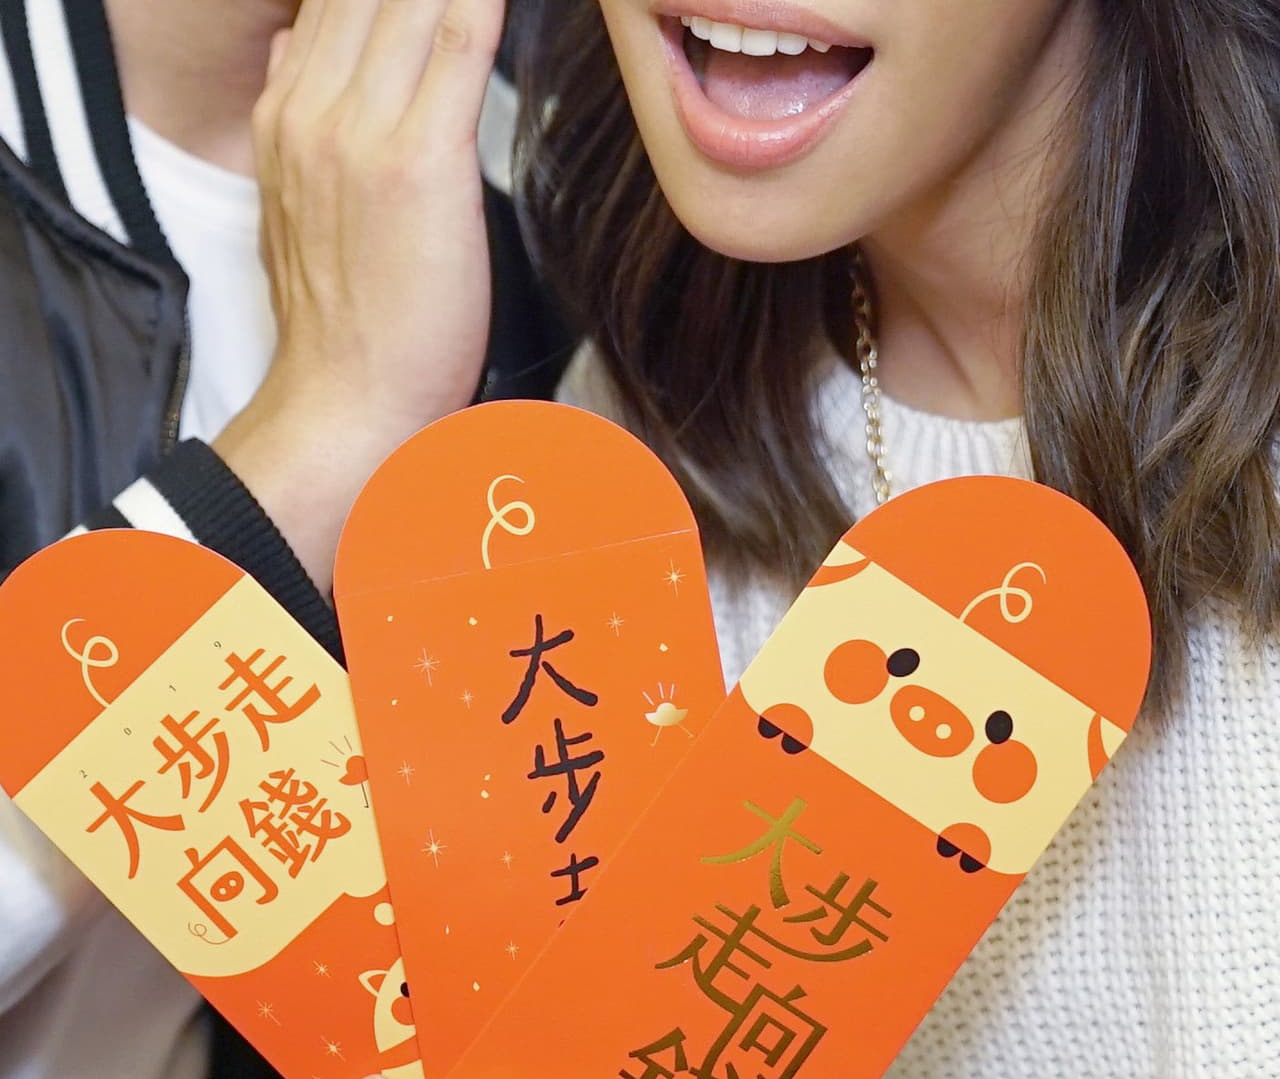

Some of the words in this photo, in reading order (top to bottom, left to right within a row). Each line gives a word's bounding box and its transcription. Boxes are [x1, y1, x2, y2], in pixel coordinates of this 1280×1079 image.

[86, 648, 321, 880] 大步走
[177, 768, 351, 938] 向錢
